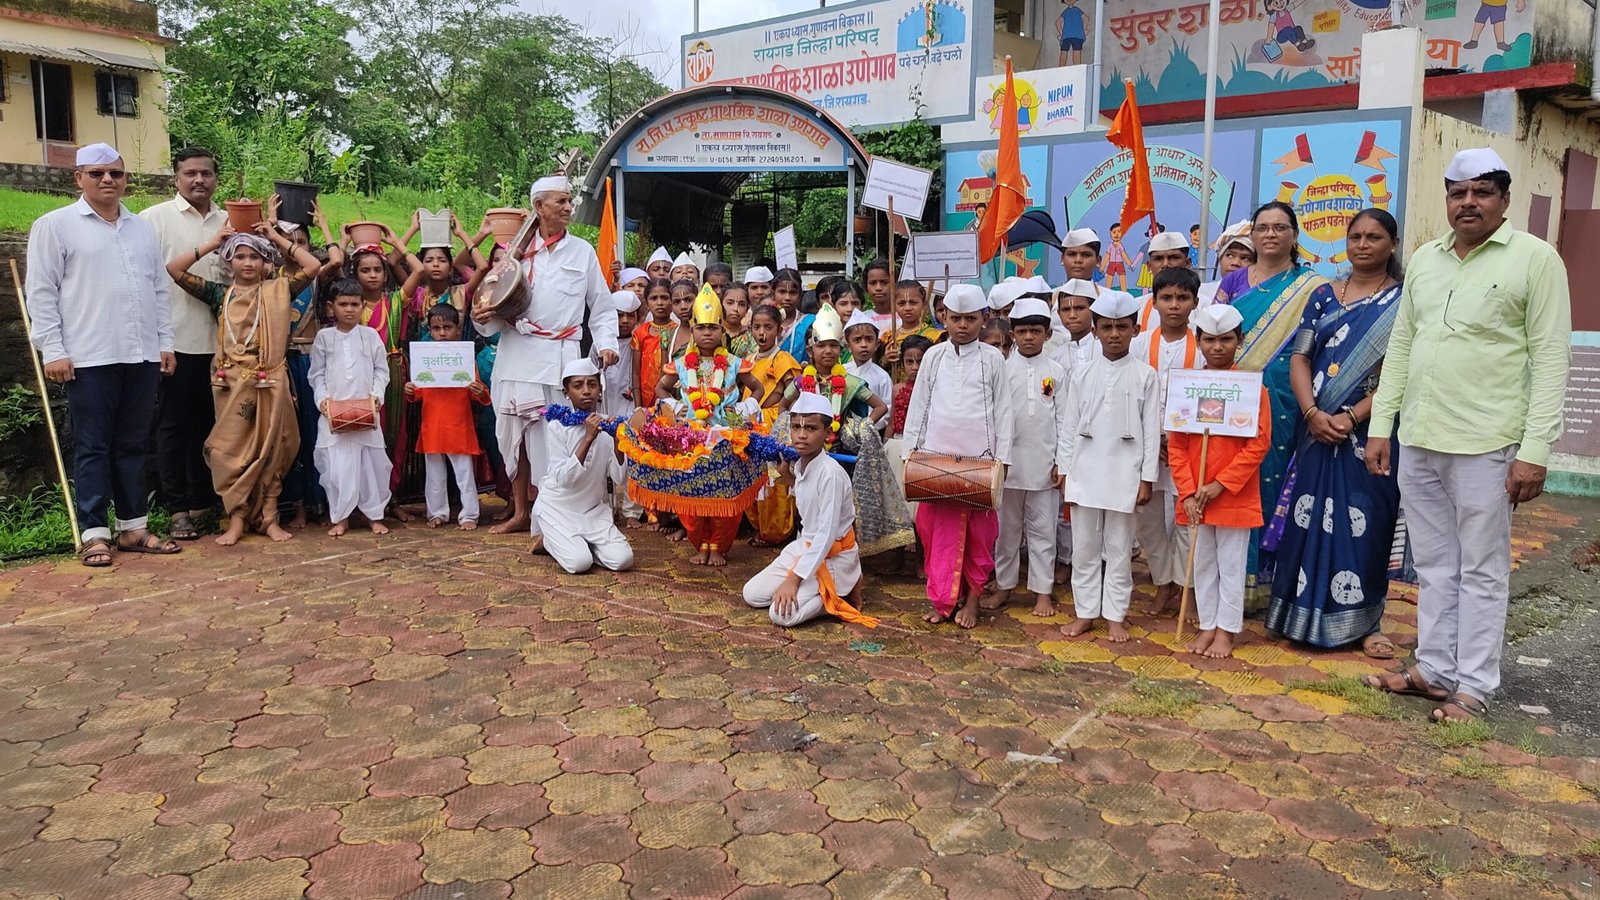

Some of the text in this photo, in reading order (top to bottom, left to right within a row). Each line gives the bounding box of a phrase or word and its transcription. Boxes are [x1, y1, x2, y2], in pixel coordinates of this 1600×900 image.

[839, 13, 865, 30] विकास
[1110, 9, 1176, 53] सुंदर
[754, 28, 880, 64] रायगड जिल्हा परिषद
[943, 46, 962, 61] चलो
[846, 50, 897, 86] उणेगाव
[1047, 84, 1073, 103] NIPUN
[757, 106, 790, 126] शाळा
[1047, 105, 1073, 120] BHARAT
[1156, 147, 1186, 163] आधार
[1152, 161, 1188, 183] अभिमान
